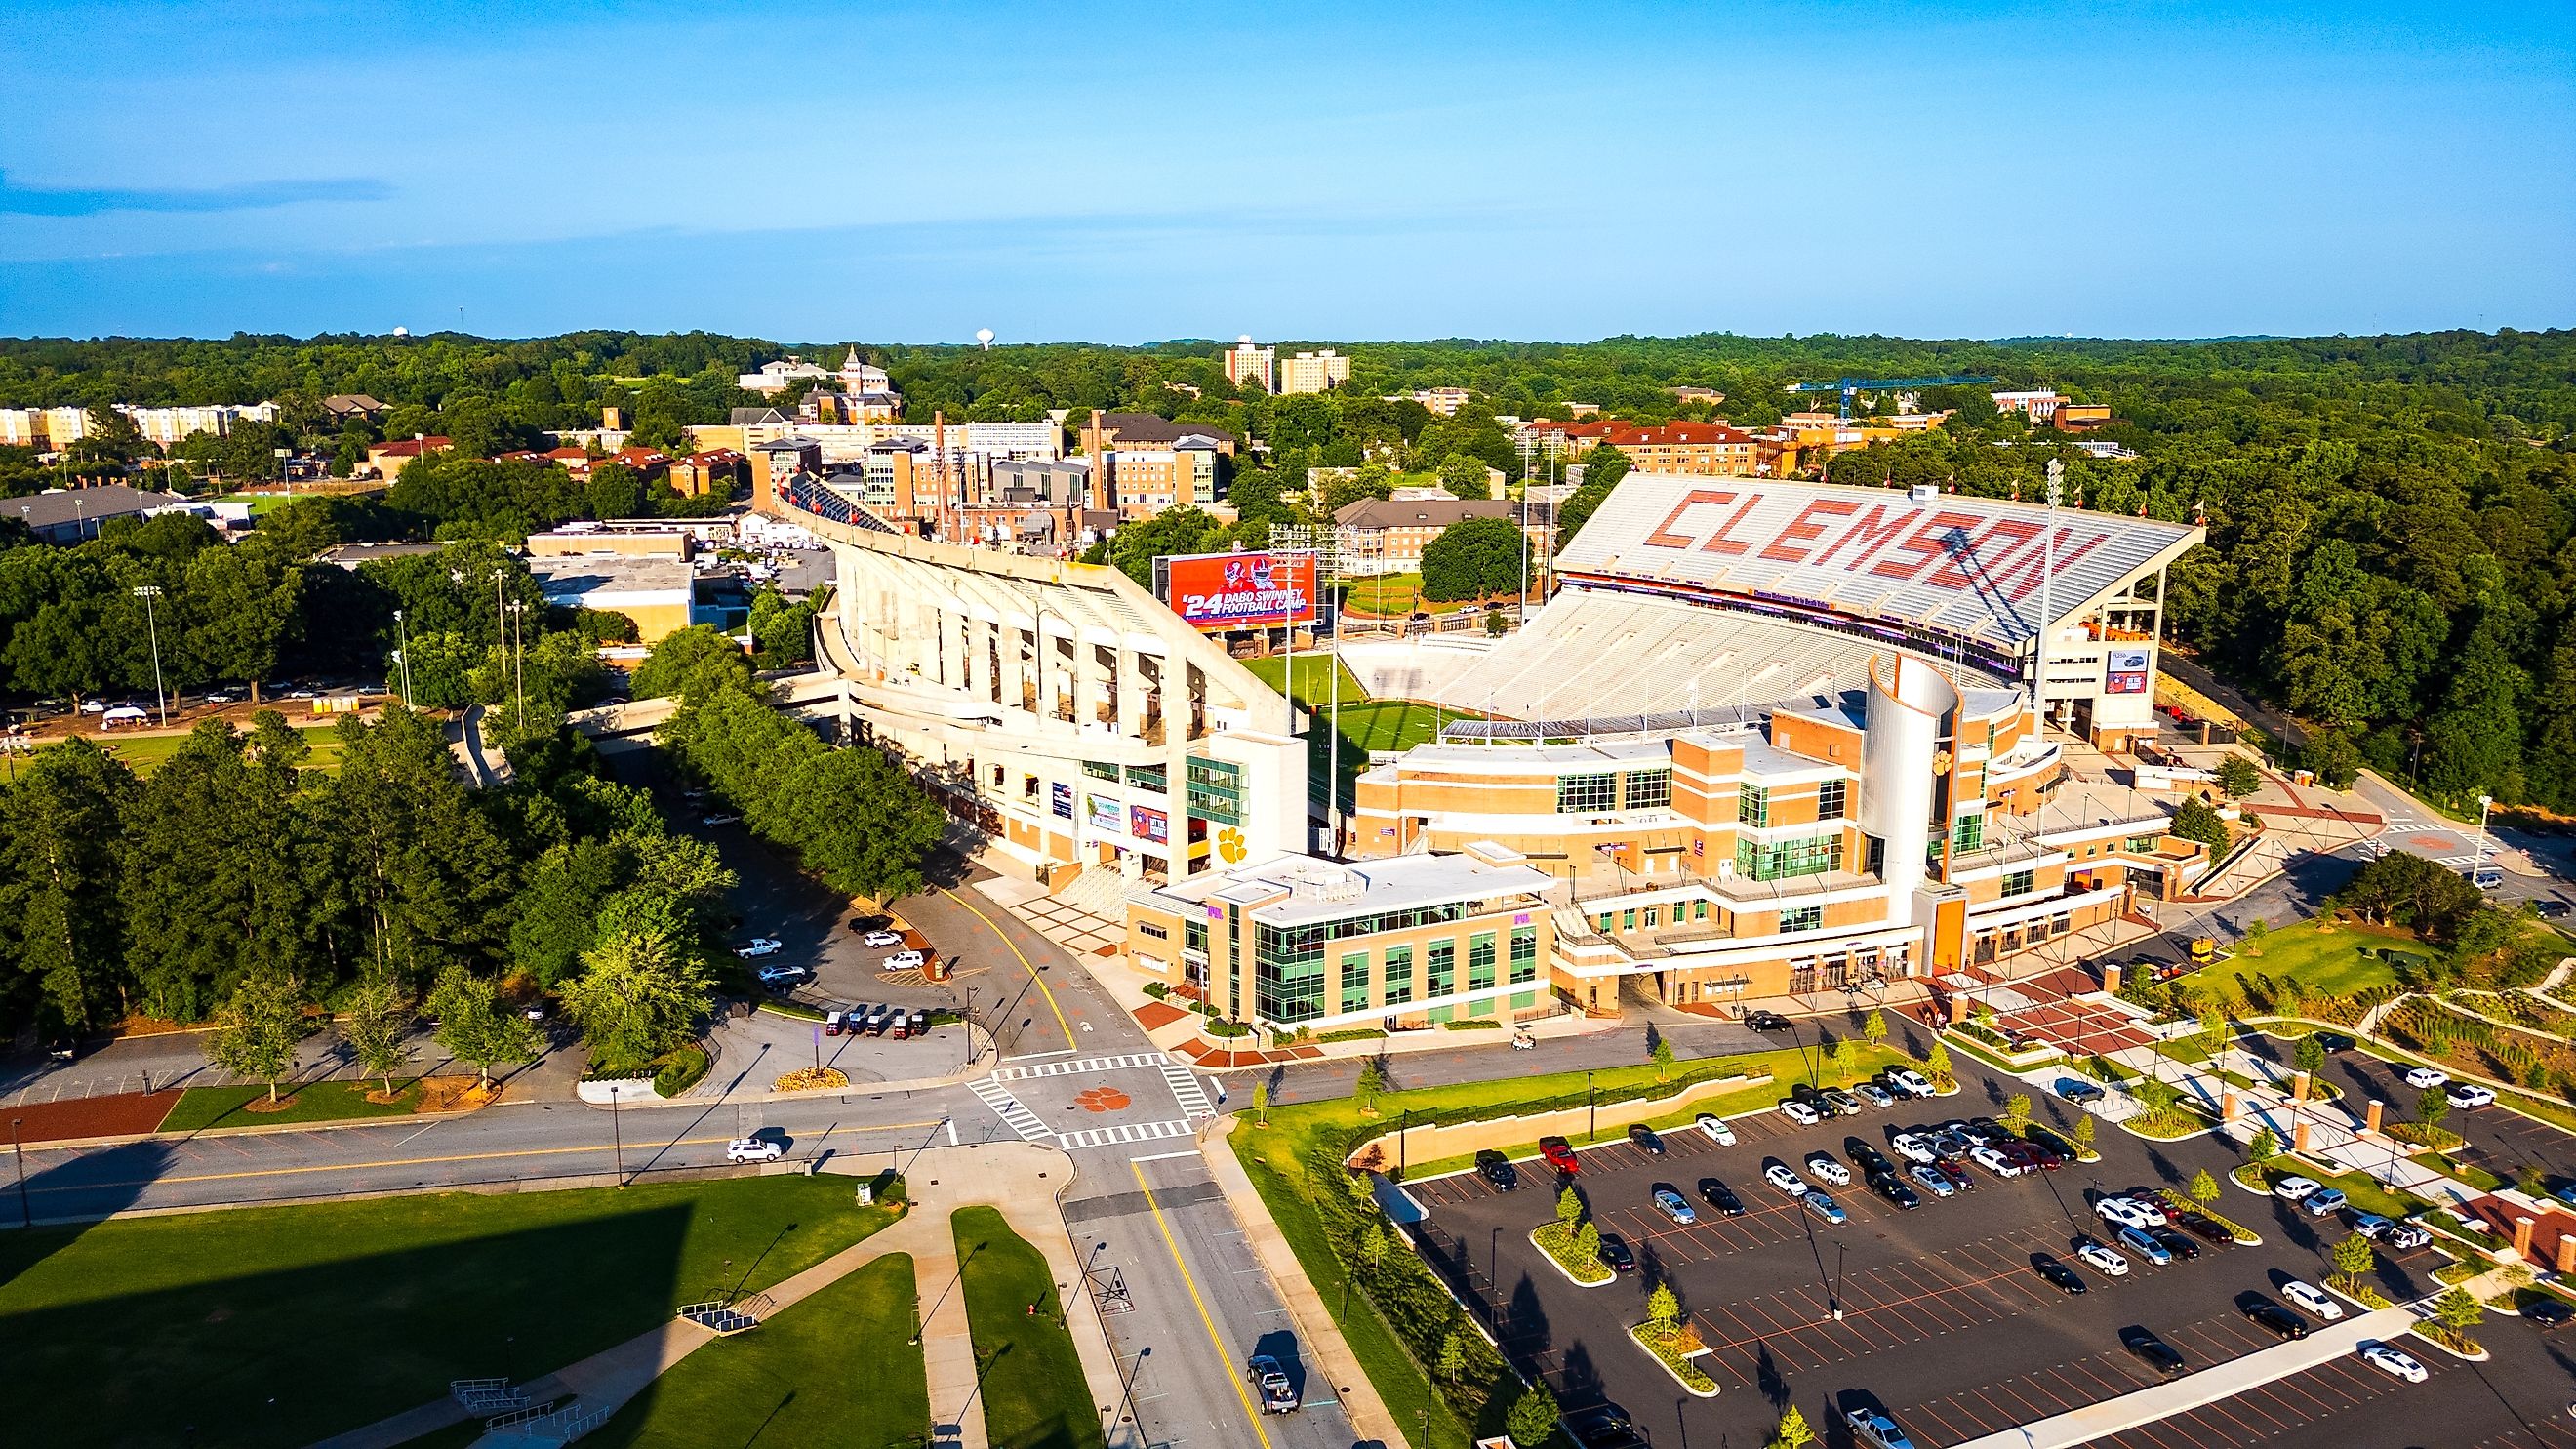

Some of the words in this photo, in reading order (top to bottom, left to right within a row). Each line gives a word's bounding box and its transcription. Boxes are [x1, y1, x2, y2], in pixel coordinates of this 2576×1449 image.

[1643, 490, 2110, 604] CLEMSON
[1224, 591, 1254, 604] DABO
[1255, 588, 1304, 602] SWINNEY
[1221, 600, 1273, 614] FOOTBALL
[1275, 598, 1306, 610] CAMP
